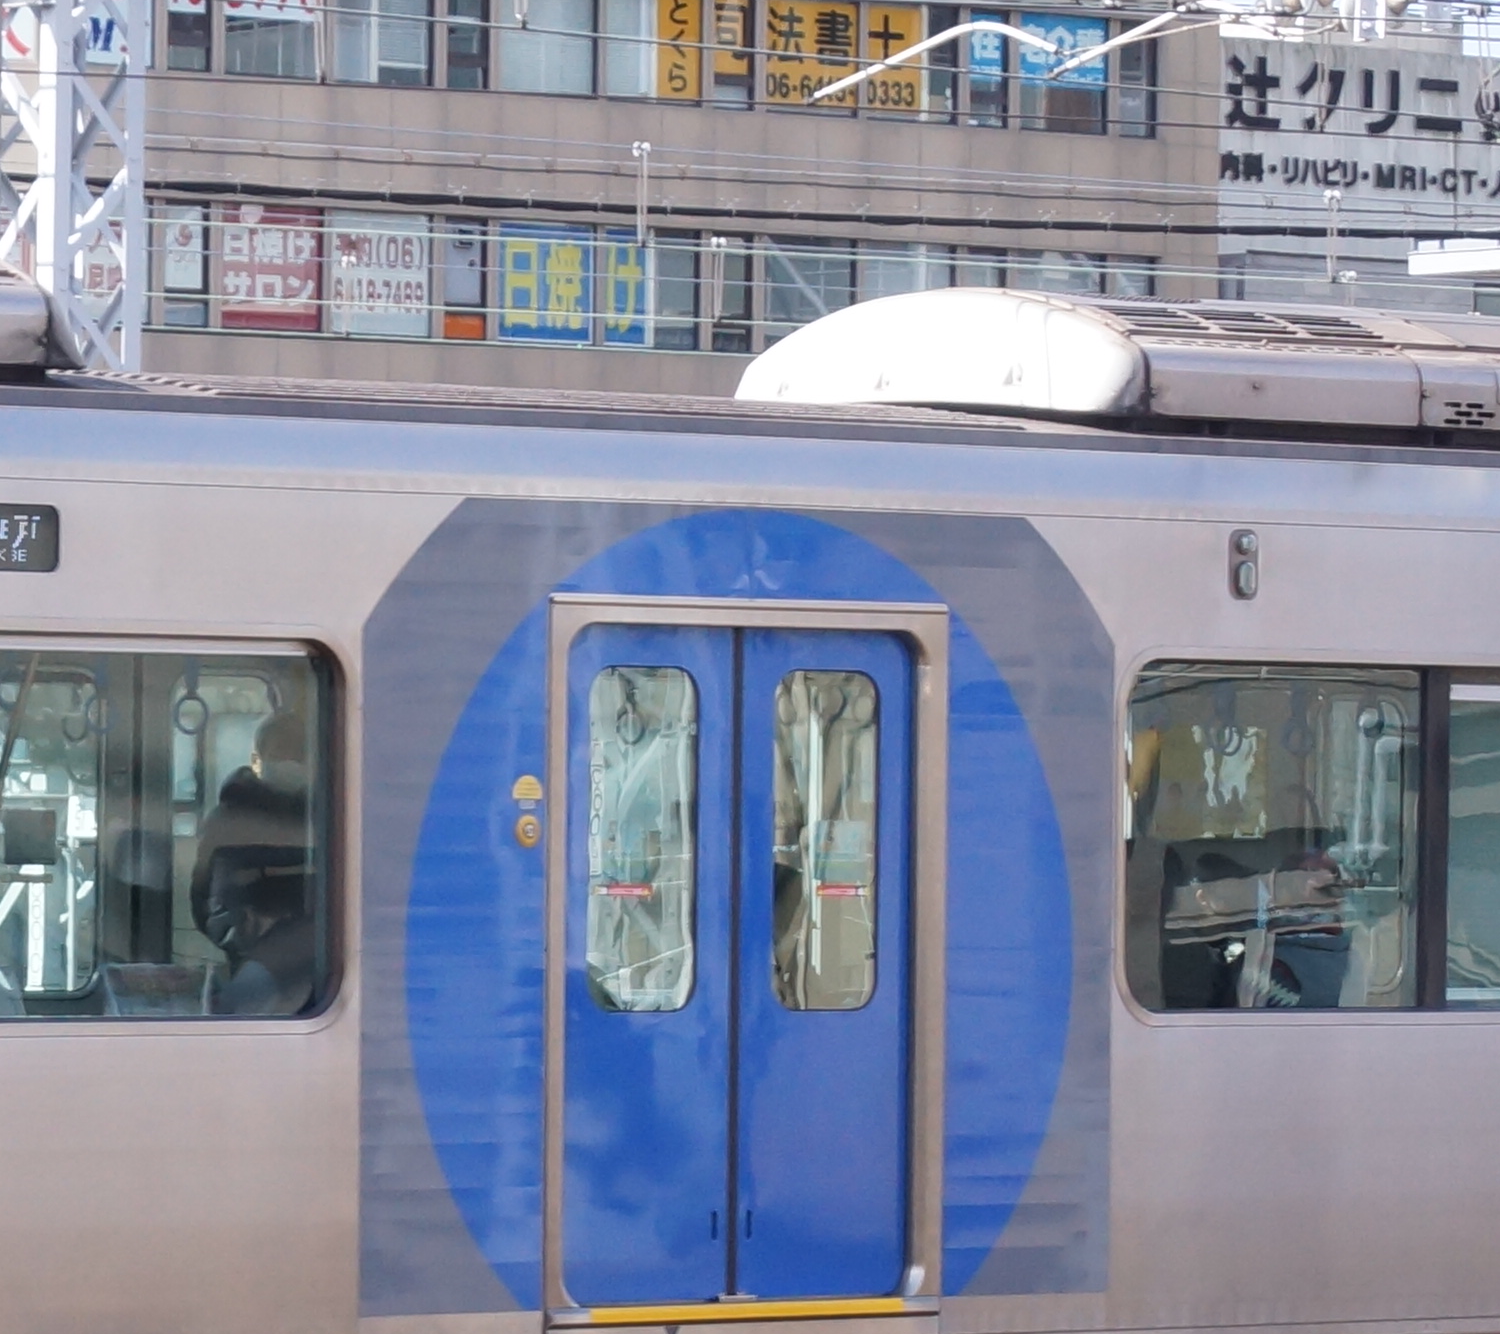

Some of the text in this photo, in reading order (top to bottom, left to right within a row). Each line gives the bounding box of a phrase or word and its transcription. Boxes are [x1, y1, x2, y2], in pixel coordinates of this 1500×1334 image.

[715, 0, 906, 71] 司法書士
[223, 227, 316, 265] 日焼け
[222, 271, 316, 307] サロン
[503, 239, 644, 333] 日焼け
